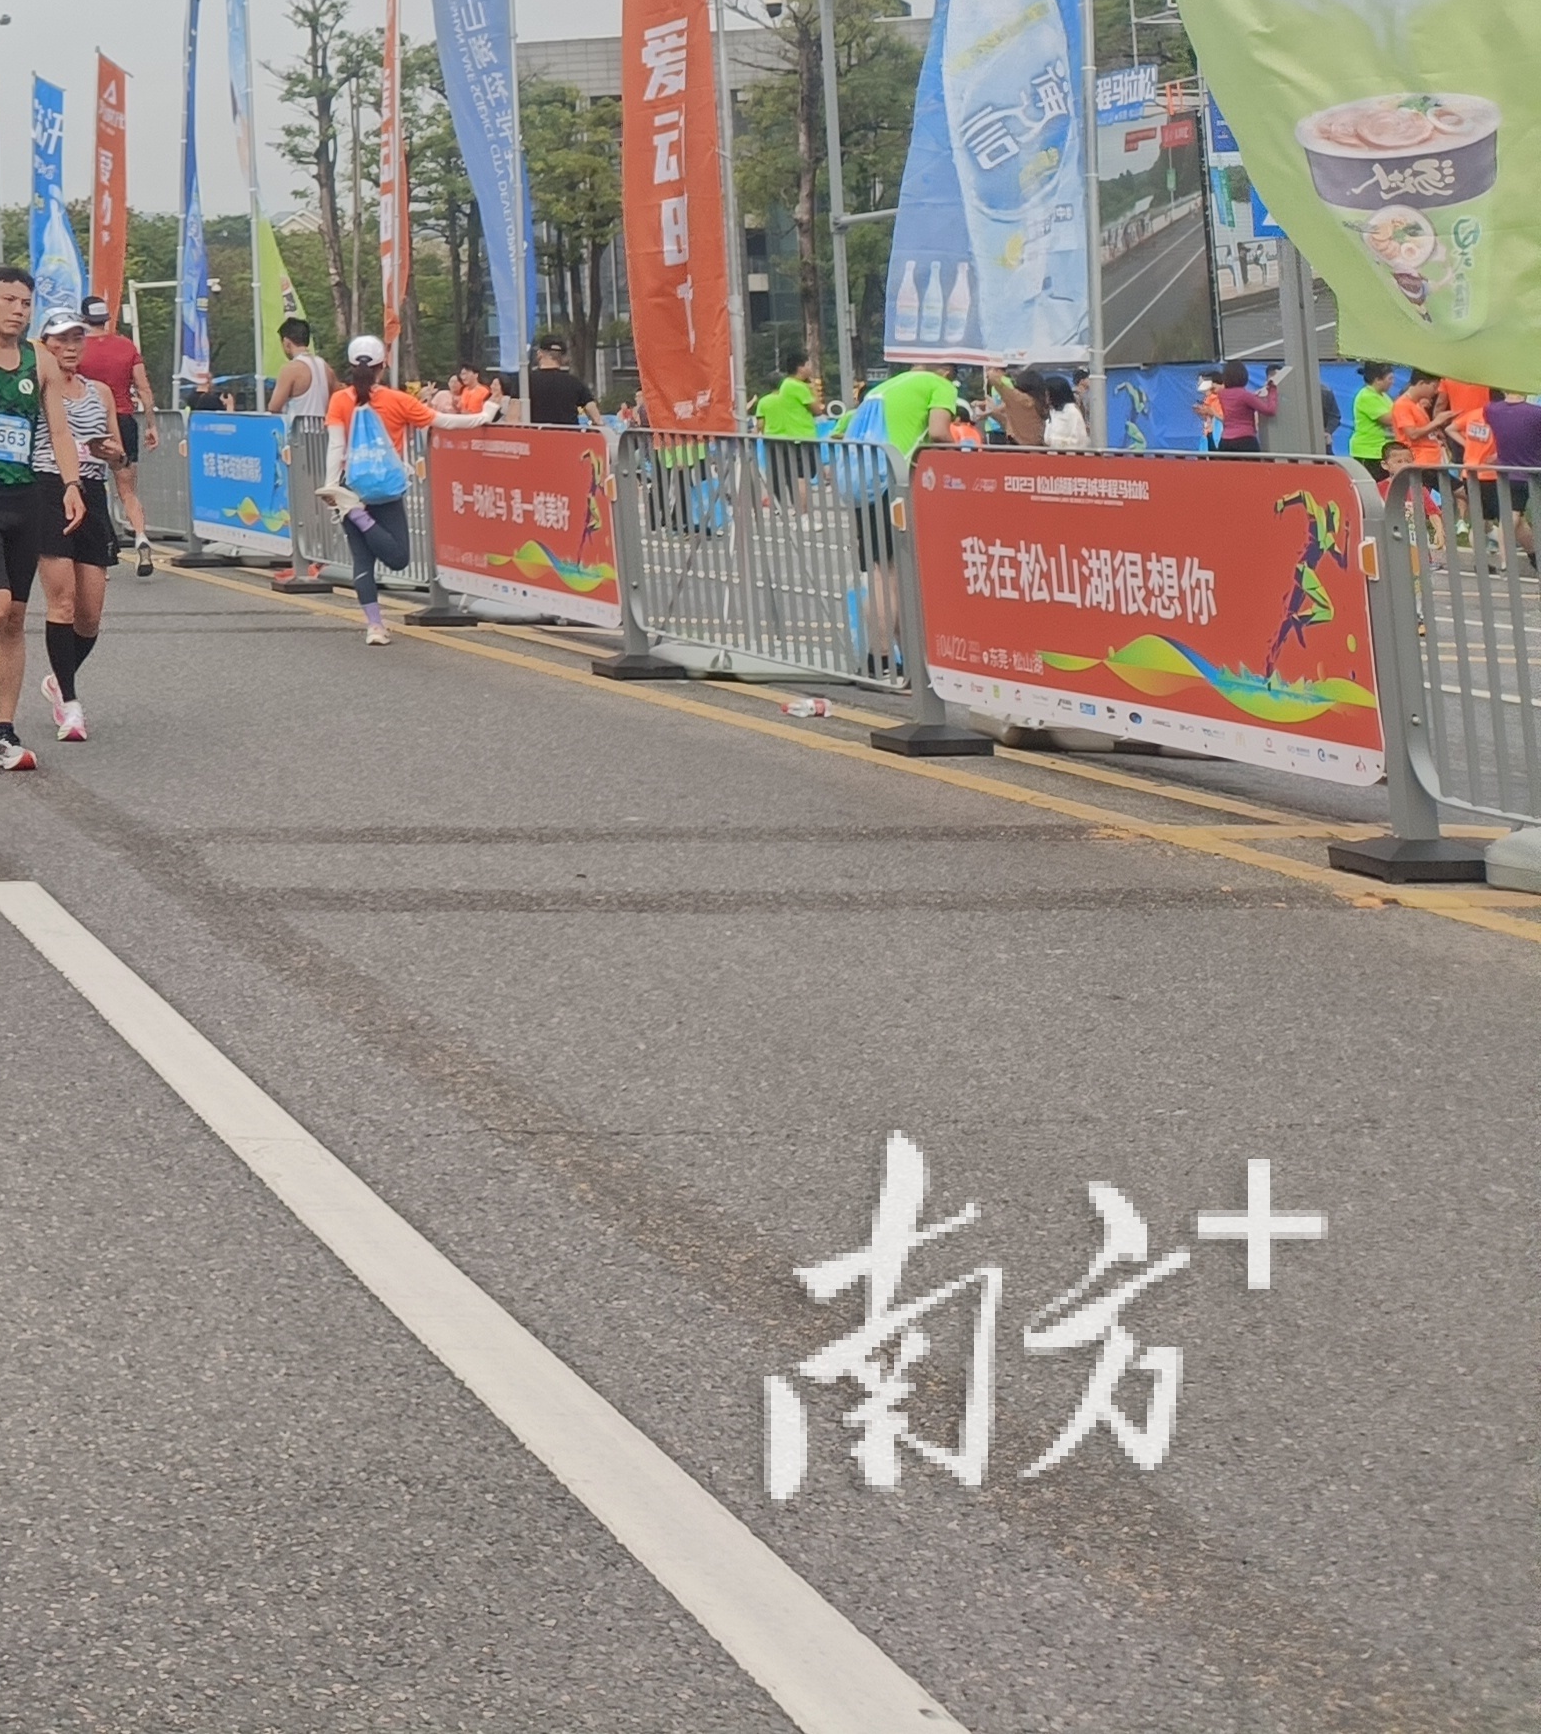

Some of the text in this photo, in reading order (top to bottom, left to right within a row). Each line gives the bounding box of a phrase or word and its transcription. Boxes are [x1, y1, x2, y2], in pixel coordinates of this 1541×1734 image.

[1003, 475, 1035, 493] 2023
[960, 534, 1217, 626] 我在松山湖很想你
